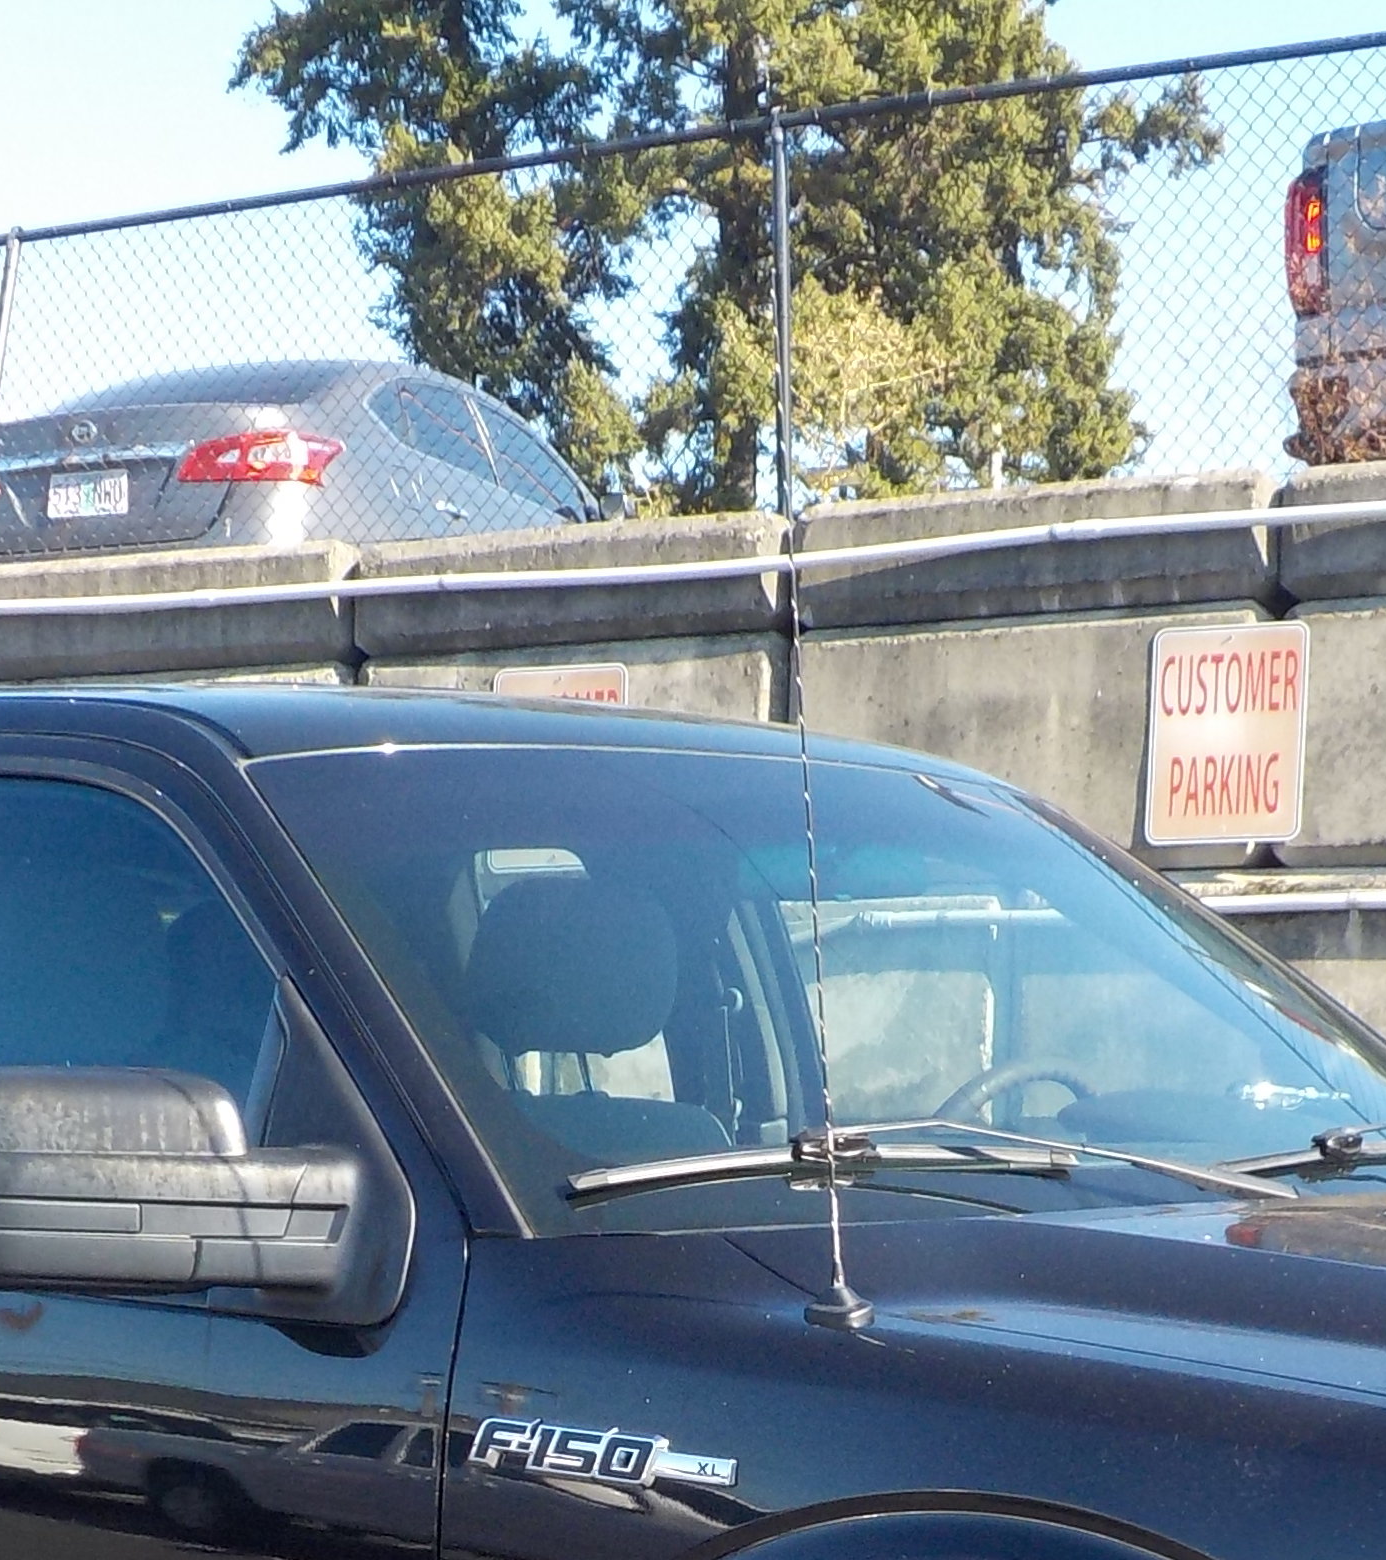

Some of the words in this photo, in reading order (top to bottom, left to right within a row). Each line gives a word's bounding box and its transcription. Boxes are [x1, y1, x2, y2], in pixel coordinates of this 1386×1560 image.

[1161, 650, 1299, 717] CUSTOMER
[1168, 753, 1280, 818] PARKING
[697, 1460, 722, 1478] XL
